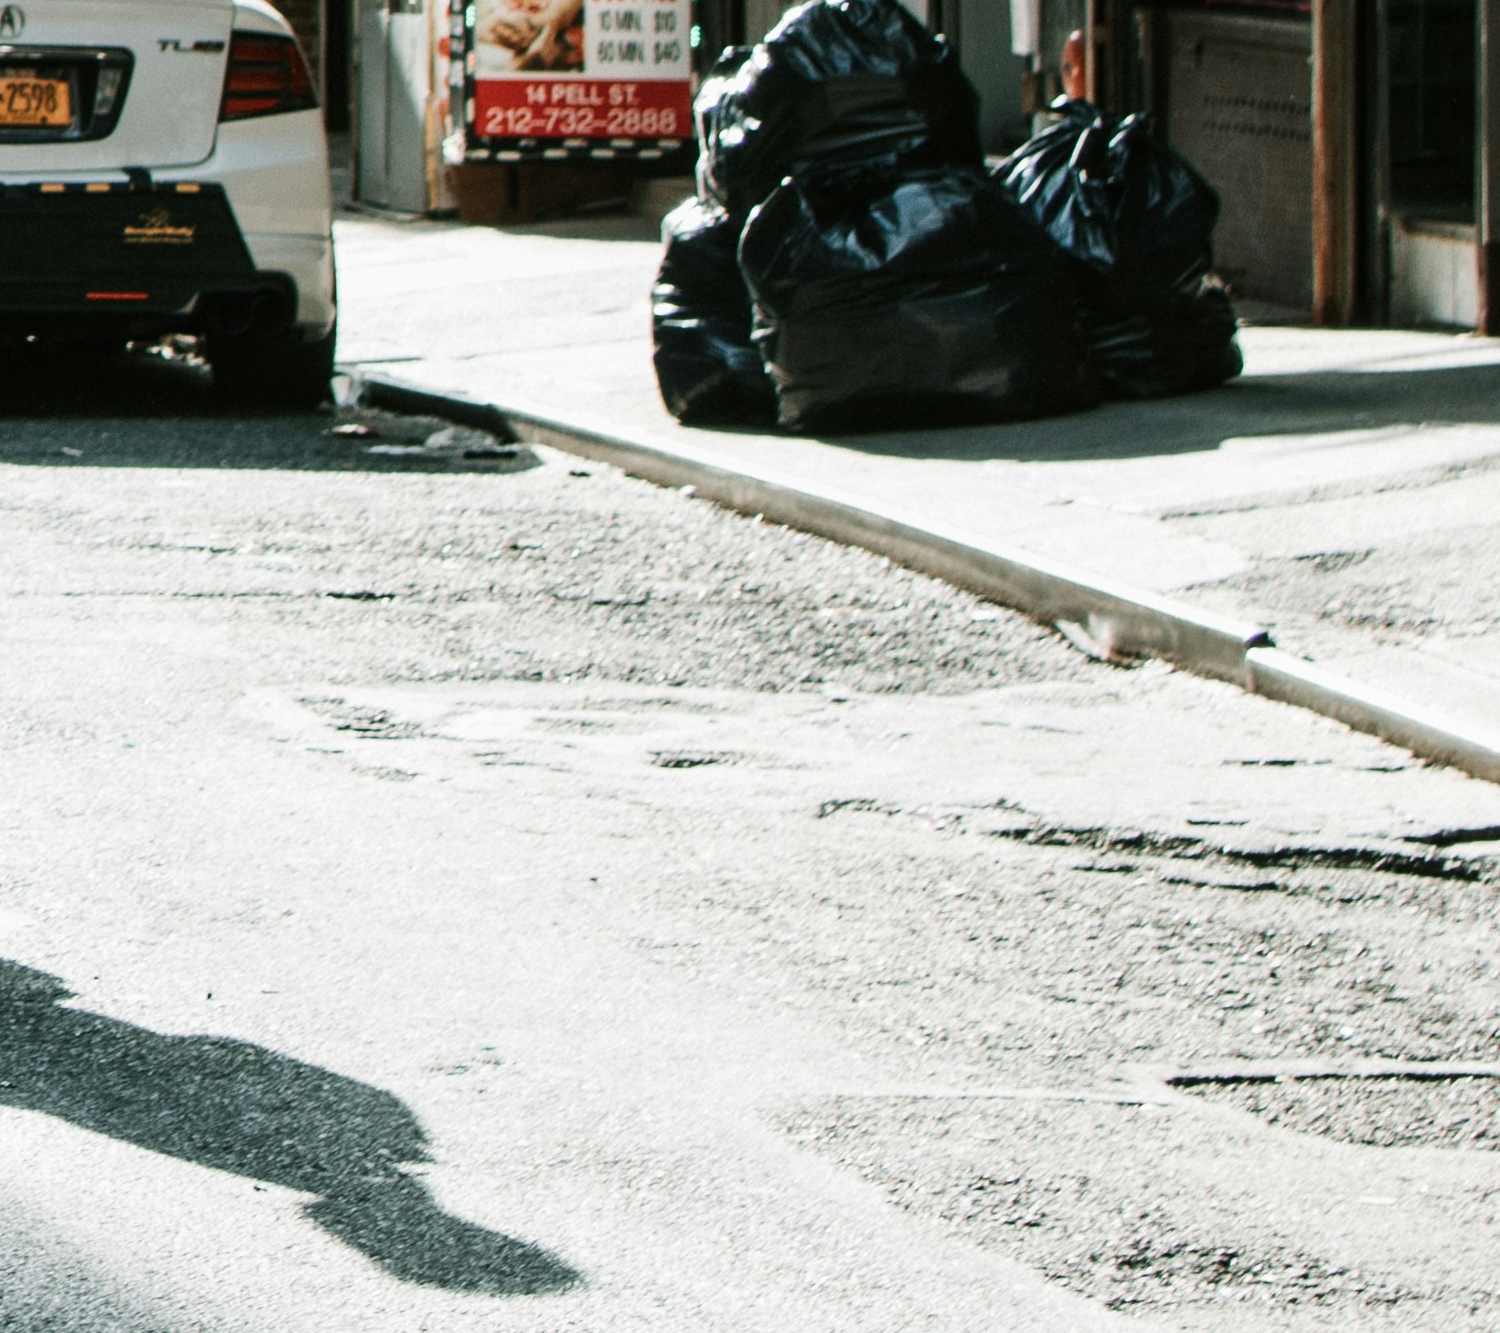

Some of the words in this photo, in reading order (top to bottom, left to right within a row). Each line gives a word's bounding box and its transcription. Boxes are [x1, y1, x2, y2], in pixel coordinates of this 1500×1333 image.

[653, 9, 677, 33] $10
[525, 86, 546, 105] 14
[552, 83, 603, 106] PELL
[486, 107, 678, 134] 212-732-2888
